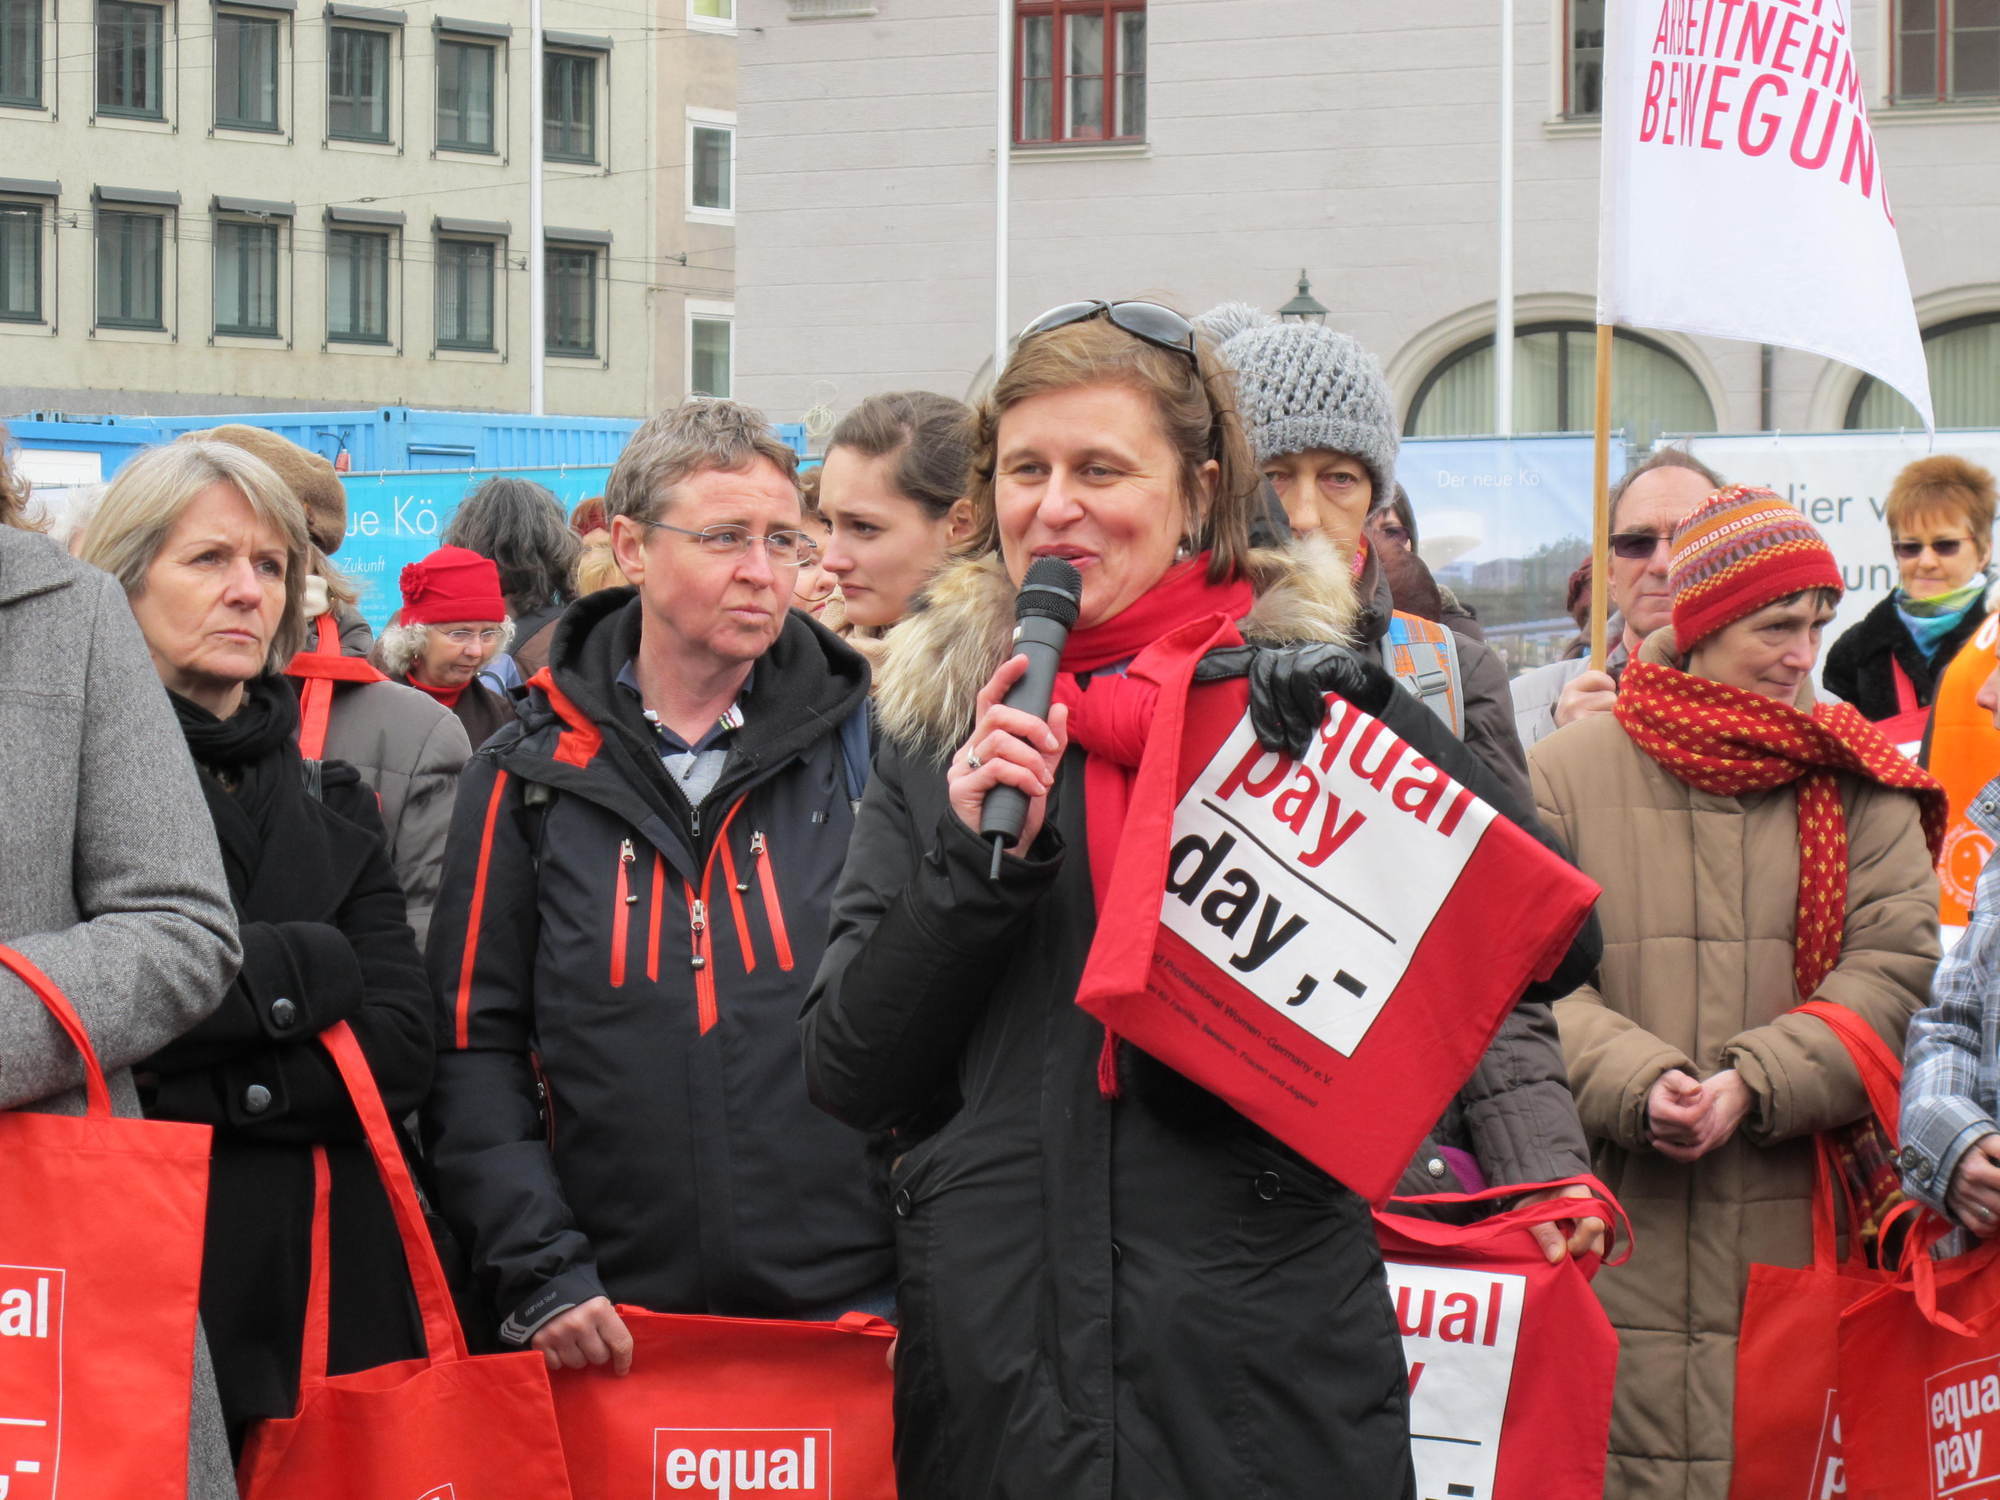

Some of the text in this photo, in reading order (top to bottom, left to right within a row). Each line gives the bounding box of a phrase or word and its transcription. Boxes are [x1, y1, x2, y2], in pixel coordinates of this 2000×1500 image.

[1640, 60, 1895, 228] BEWEGUN
[1438, 470, 1466, 488] Der
[1471, 475, 1512, 489] neue
[394, 494, 438, 536] Kö
[342, 555, 386, 574] Zukunft
[1843, 563, 1892, 592] un
[1215, 742, 1368, 869] pay
[1164, 958, 1224, 1009] Professional
[1224, 1004, 1262, 1038] Women
[1266, 1036, 1313, 1074] Germany
[1388, 1282, 1504, 1347] ual
[1931, 1370, 2000, 1432] equa
[666, 1437, 816, 1500] equal
[1934, 1429, 1982, 1489] pay
